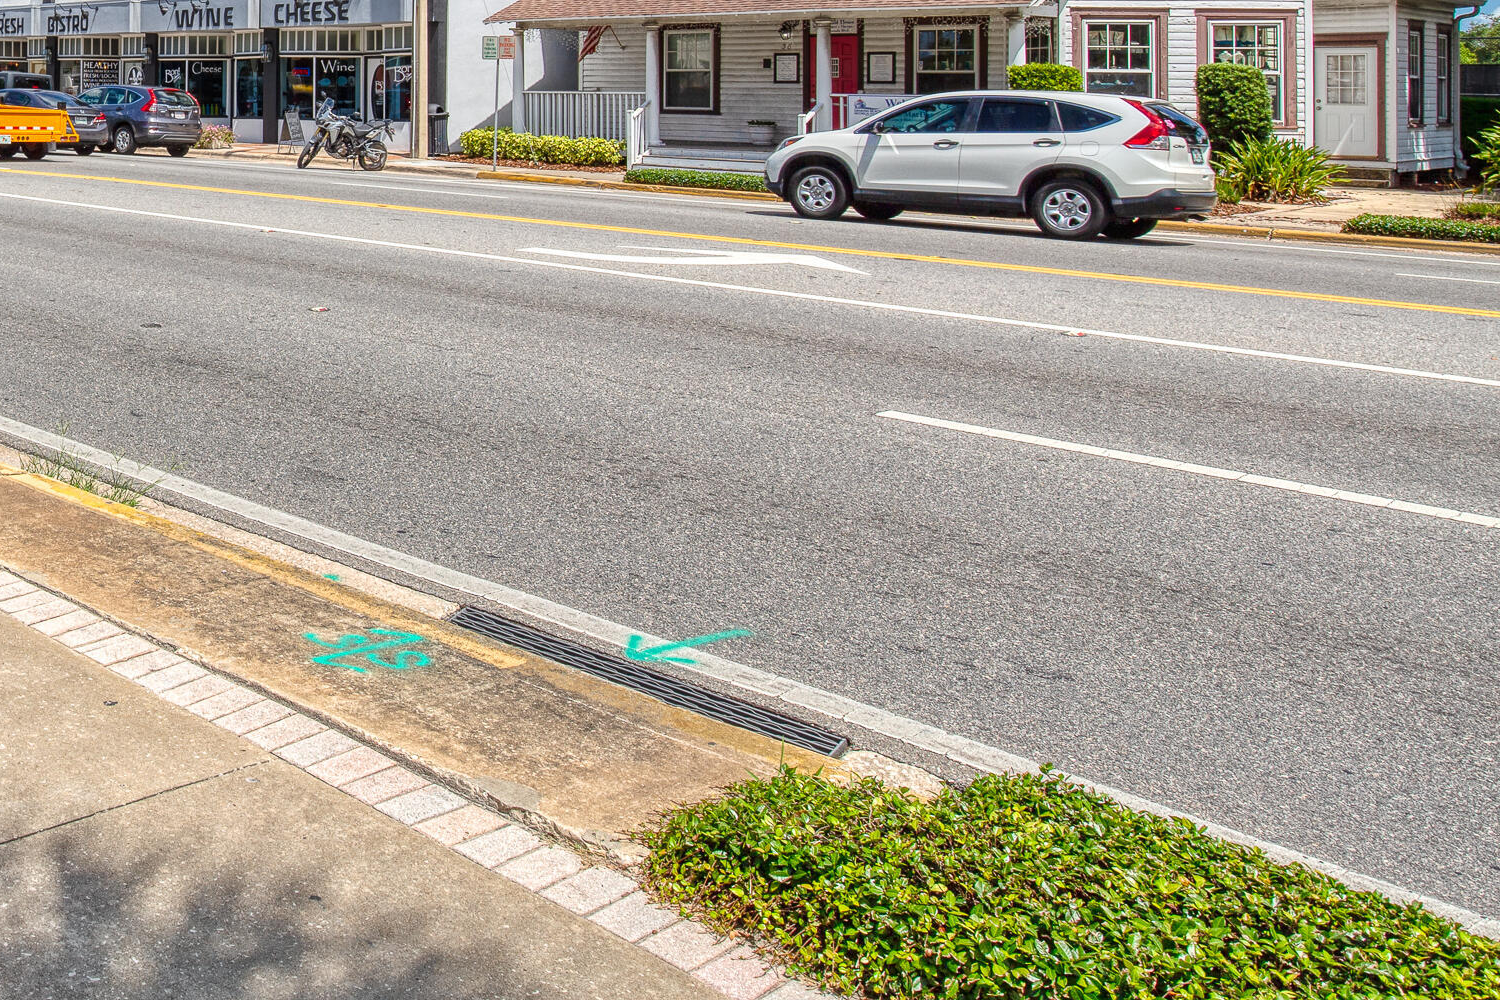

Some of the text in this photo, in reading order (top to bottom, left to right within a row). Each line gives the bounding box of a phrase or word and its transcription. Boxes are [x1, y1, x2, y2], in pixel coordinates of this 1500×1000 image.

[175, 6, 234, 28] WINE
[274, 0, 349, 24] CHEESE
[47, 14, 89, 33] BISTRO
[83, 61, 118, 69] HEALTHY
[191, 61, 222, 75] Cheese
[320, 59, 356, 74] Wine
